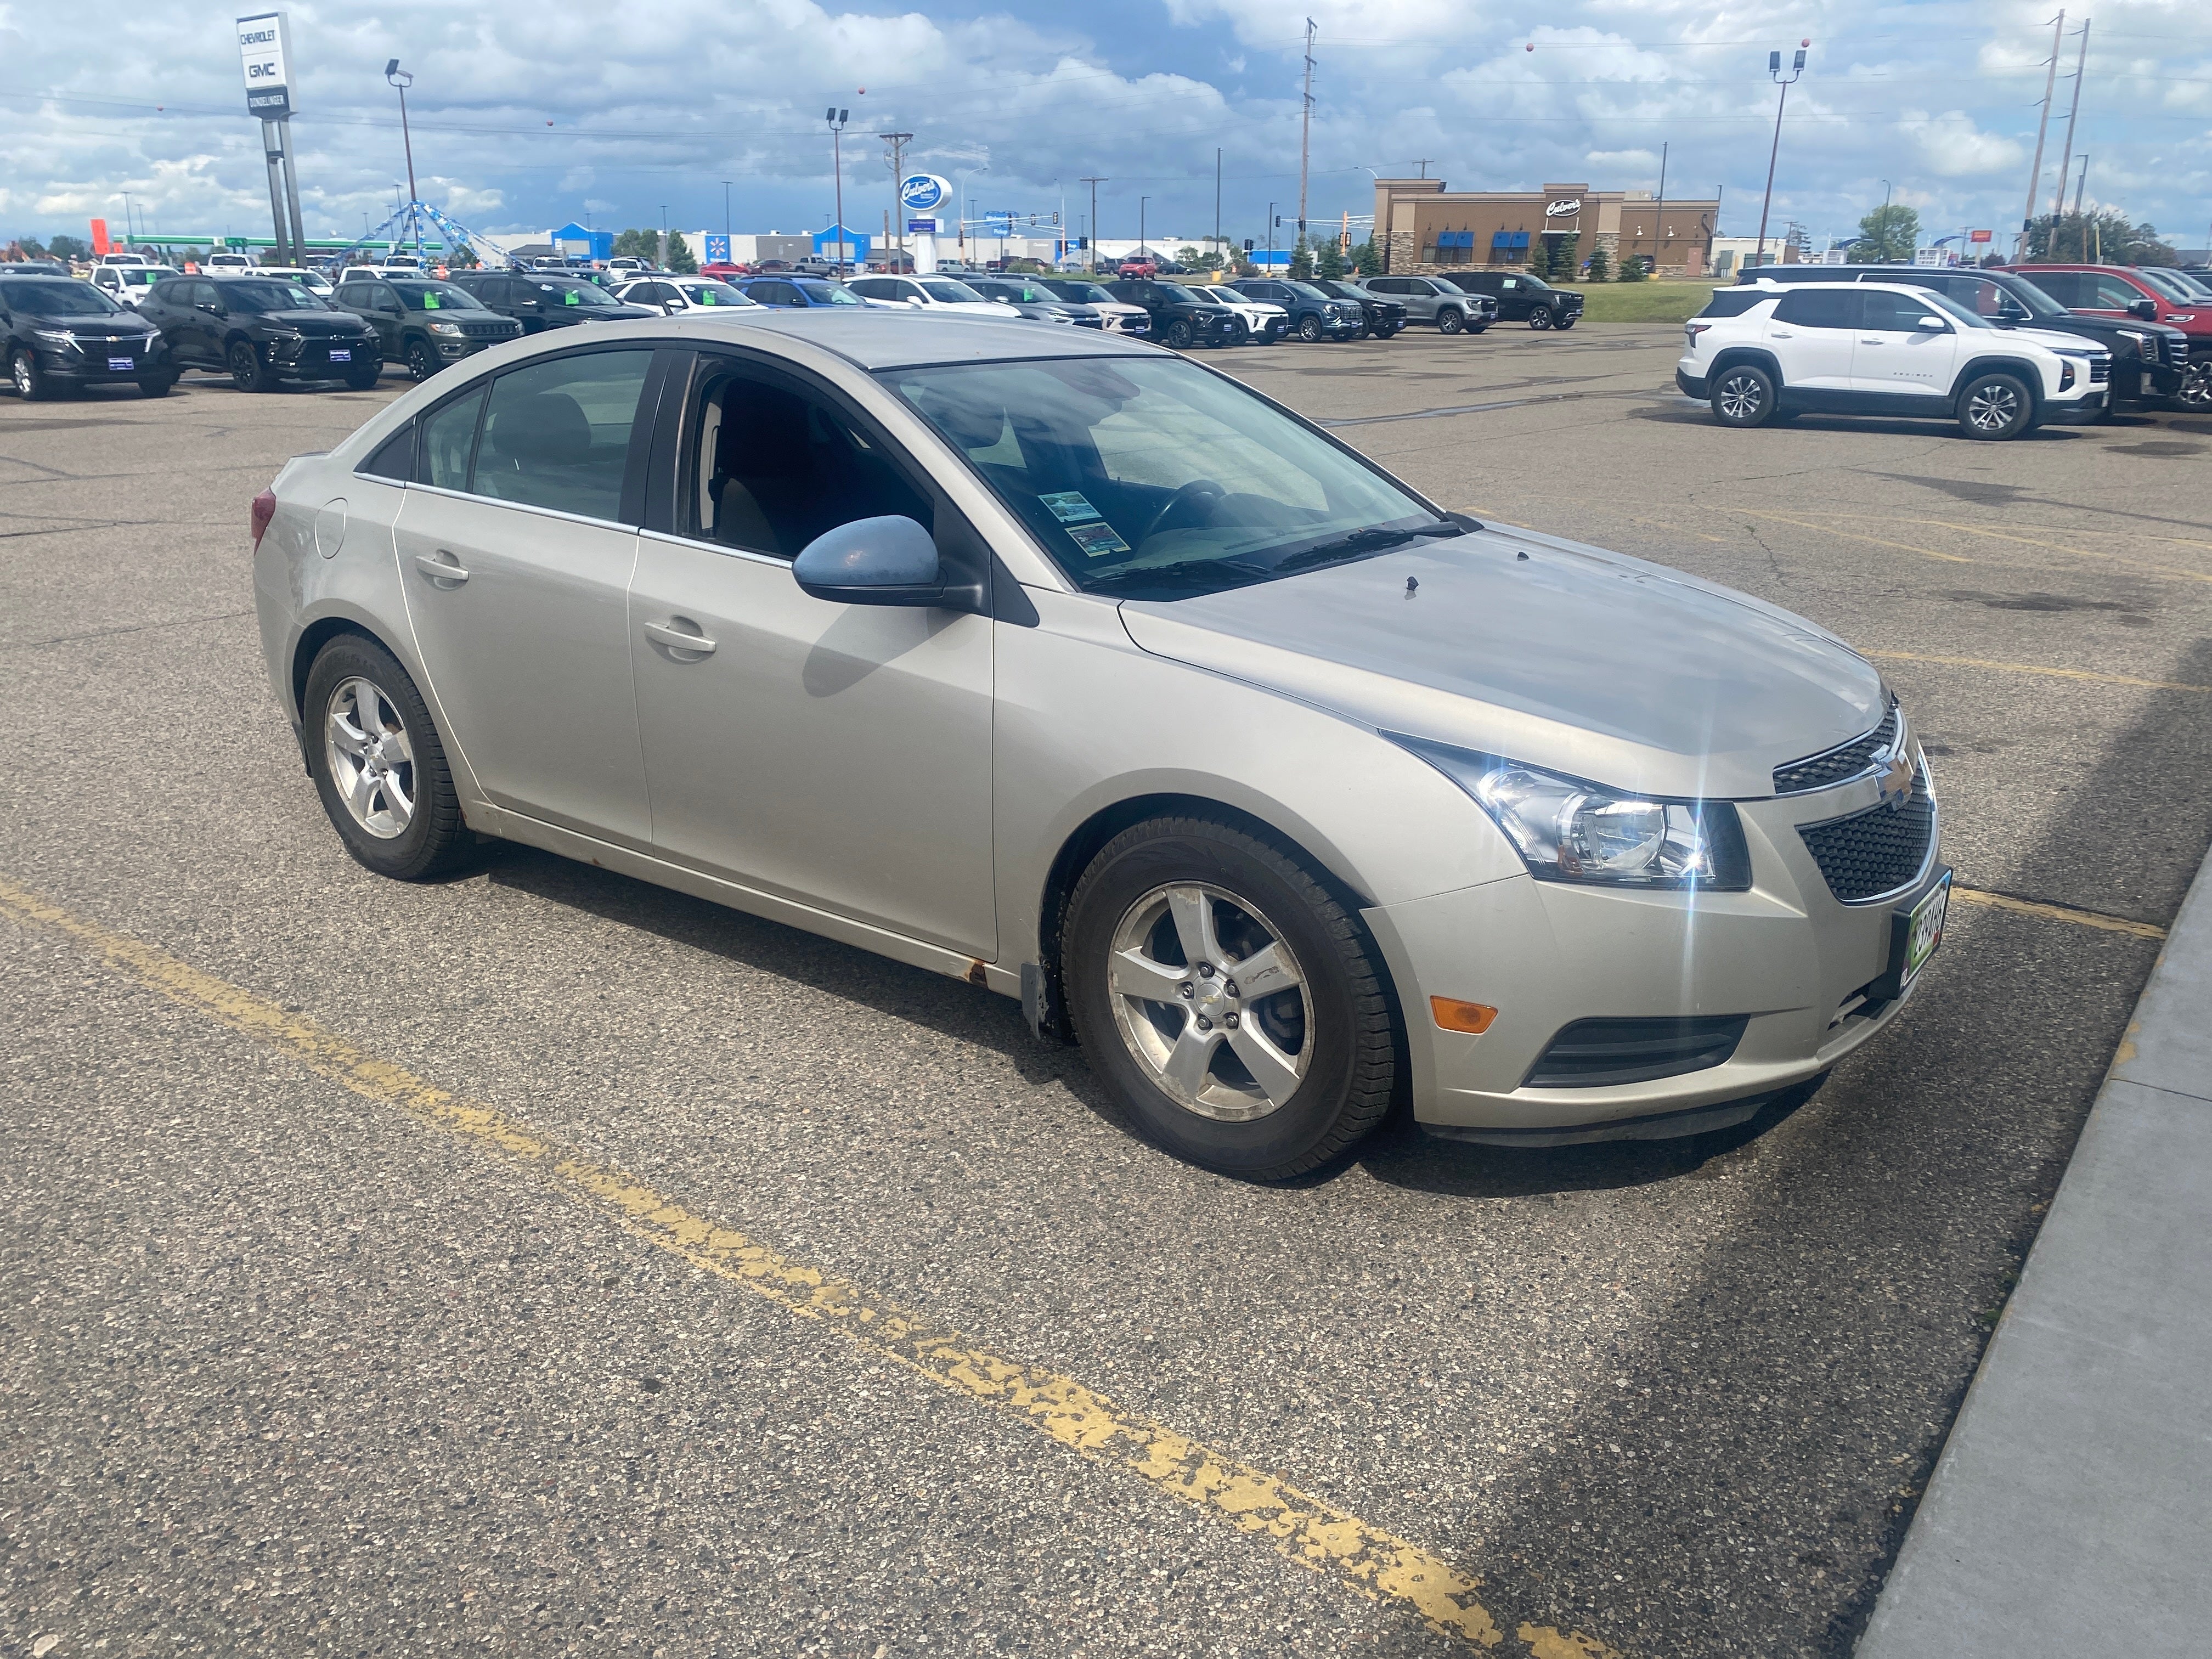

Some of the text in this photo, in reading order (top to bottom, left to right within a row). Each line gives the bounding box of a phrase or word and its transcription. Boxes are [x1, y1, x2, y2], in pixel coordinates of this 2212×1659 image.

[240, 30, 275, 44] CHEVROLET
[249, 63, 275, 77] GMC
[249, 94, 285, 108] DONDELINGER
[902, 178, 936, 201] Culver's
[1546, 199, 1581, 216] Culver's
